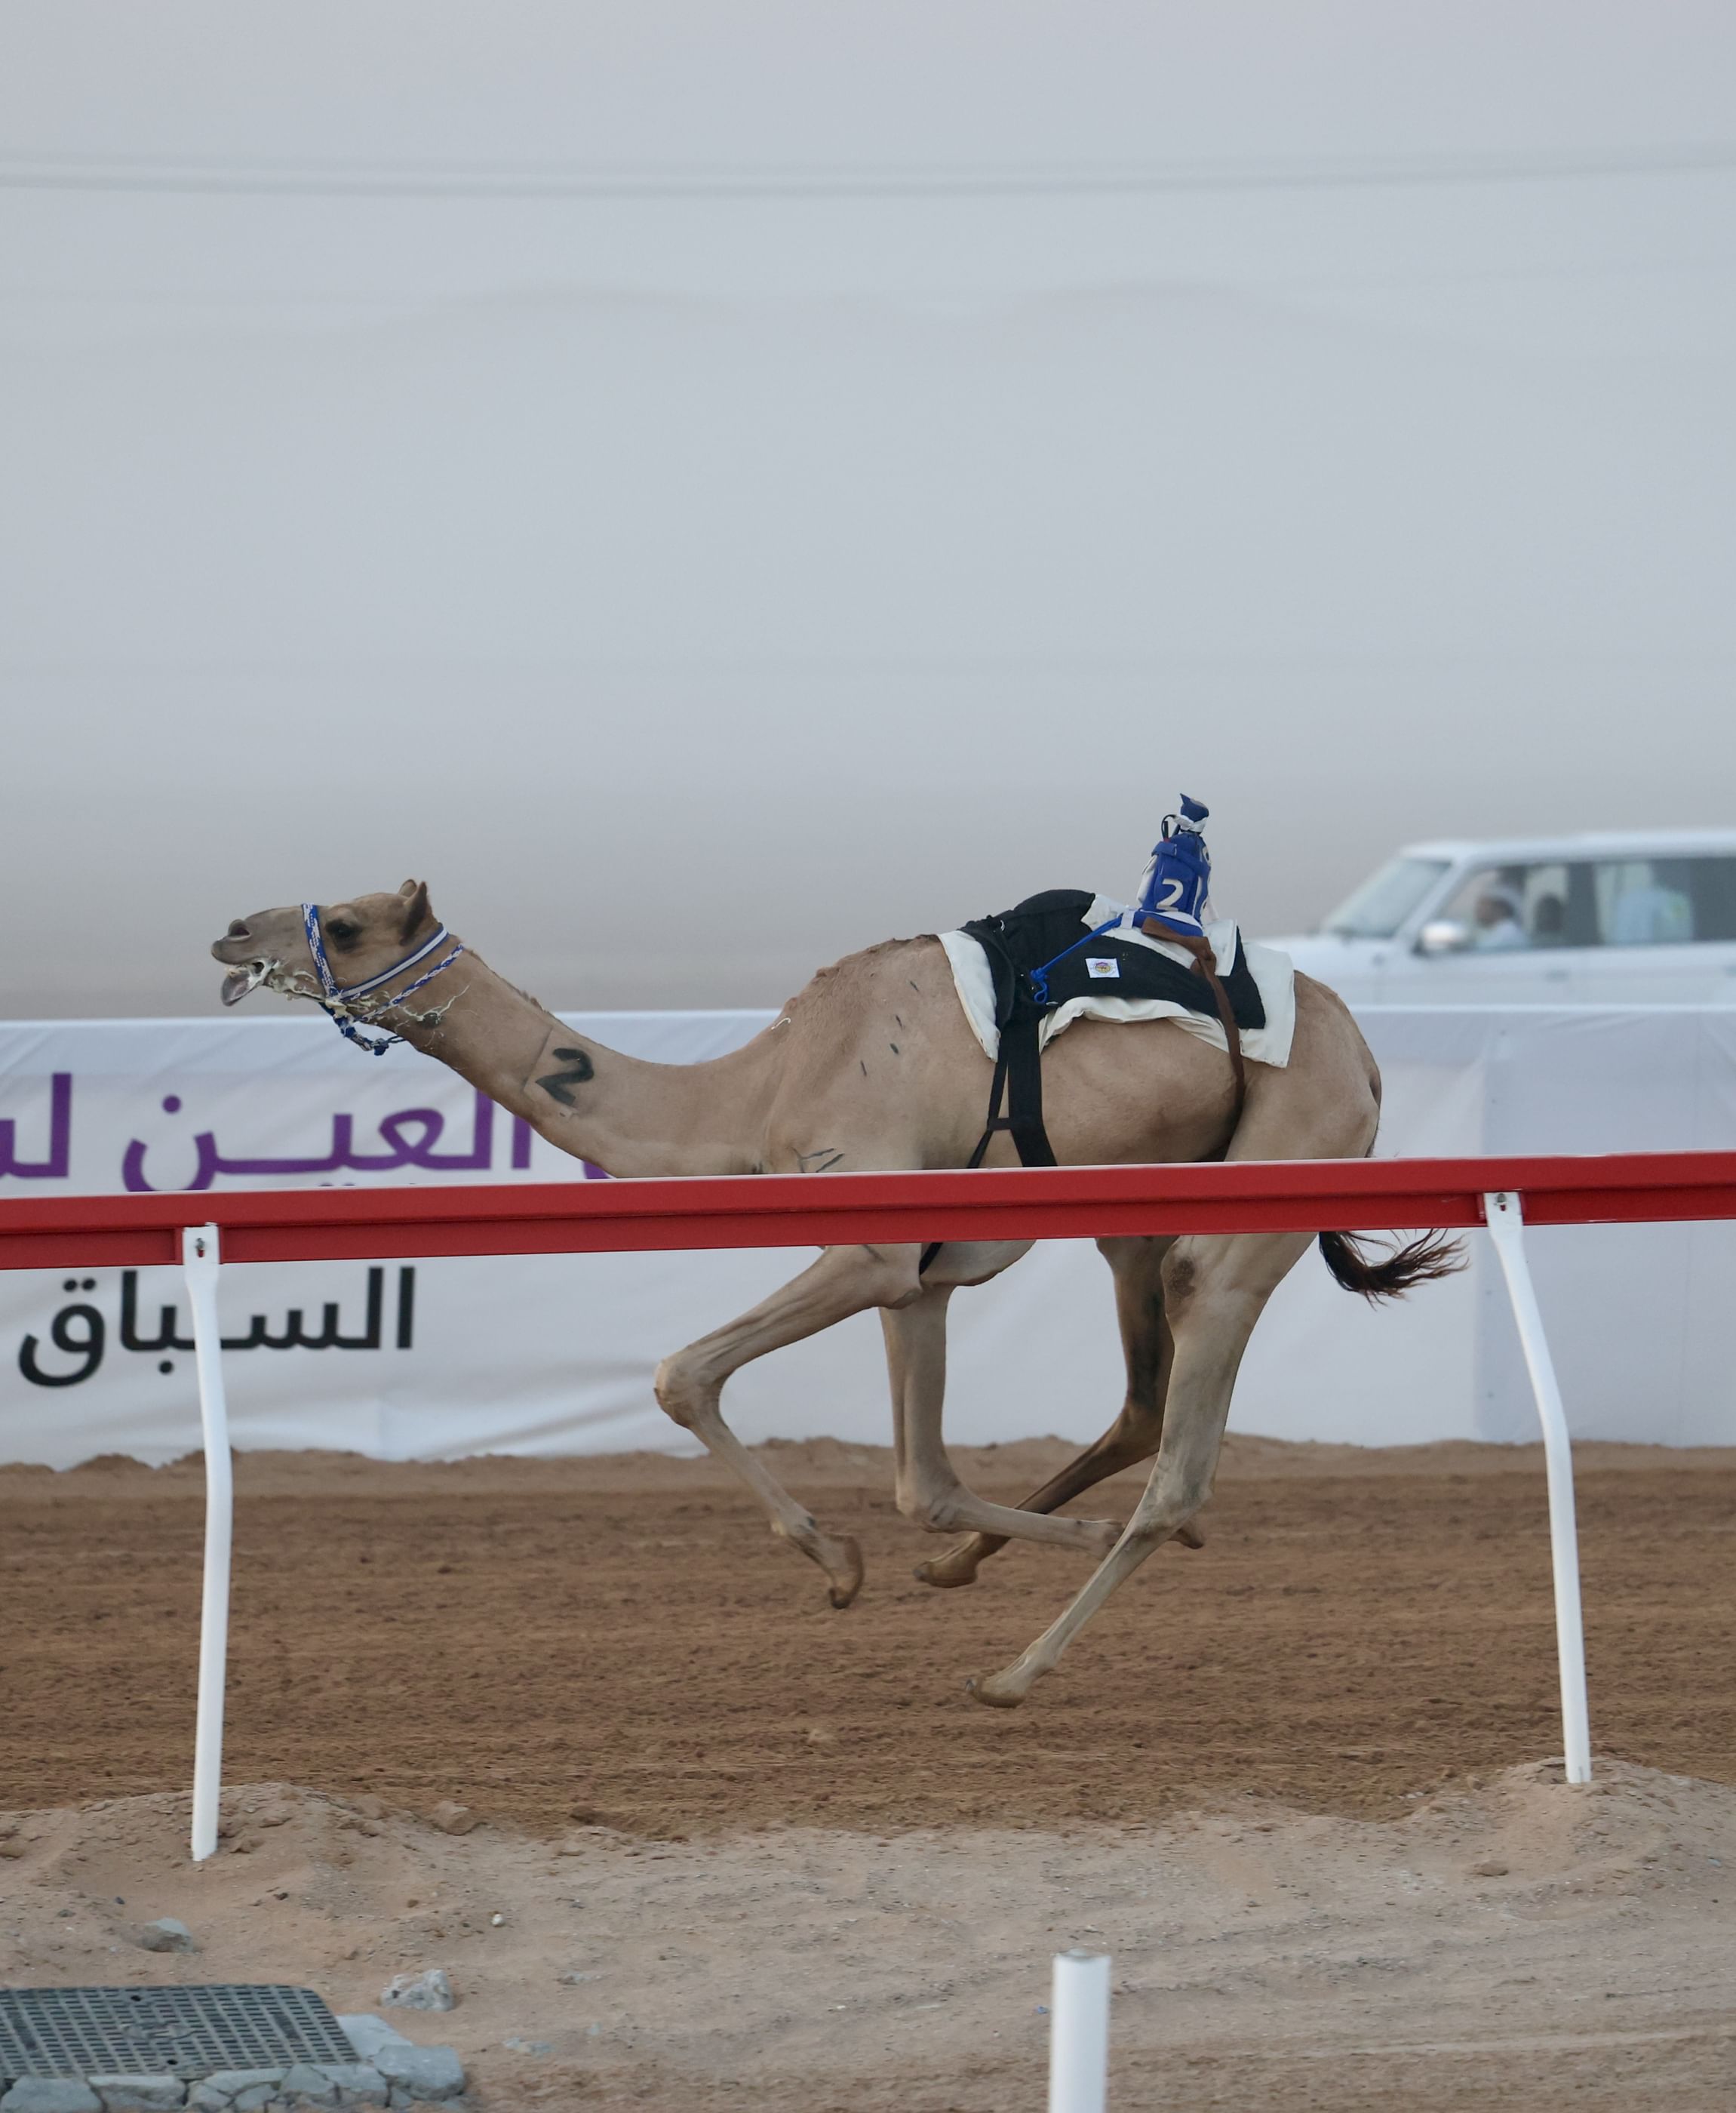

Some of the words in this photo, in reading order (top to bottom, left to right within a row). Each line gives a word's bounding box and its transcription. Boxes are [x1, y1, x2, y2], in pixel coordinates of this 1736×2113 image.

[1156, 878, 1184, 912] 2
[535, 1047, 595, 1106] 2
[18, 1266, 416, 1389] السباق
